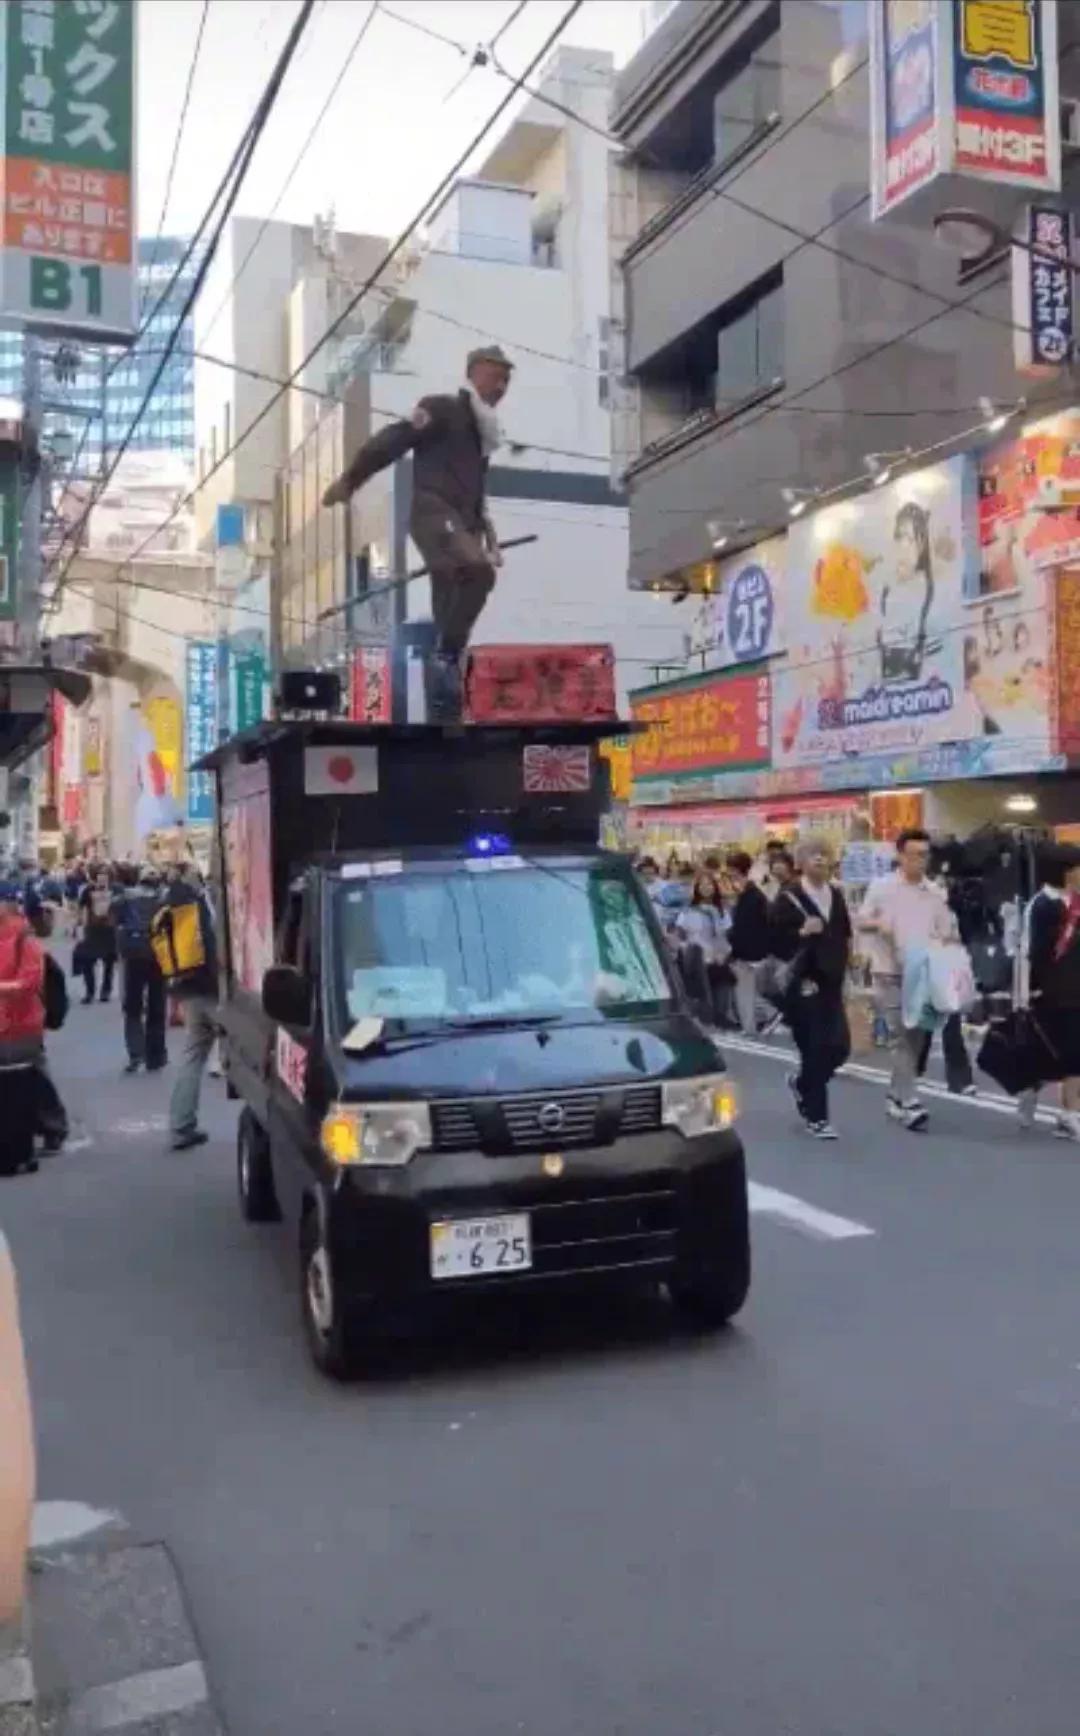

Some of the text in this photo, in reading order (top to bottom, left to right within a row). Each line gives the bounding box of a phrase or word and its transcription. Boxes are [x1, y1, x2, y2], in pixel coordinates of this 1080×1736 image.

[31, 165, 106, 196] 入口は
[31, 256, 102, 316] B1
[736, 598, 768, 652] 2F
[843, 685, 951, 723] maidreamin
[495, 1237, 525, 1267] 25
